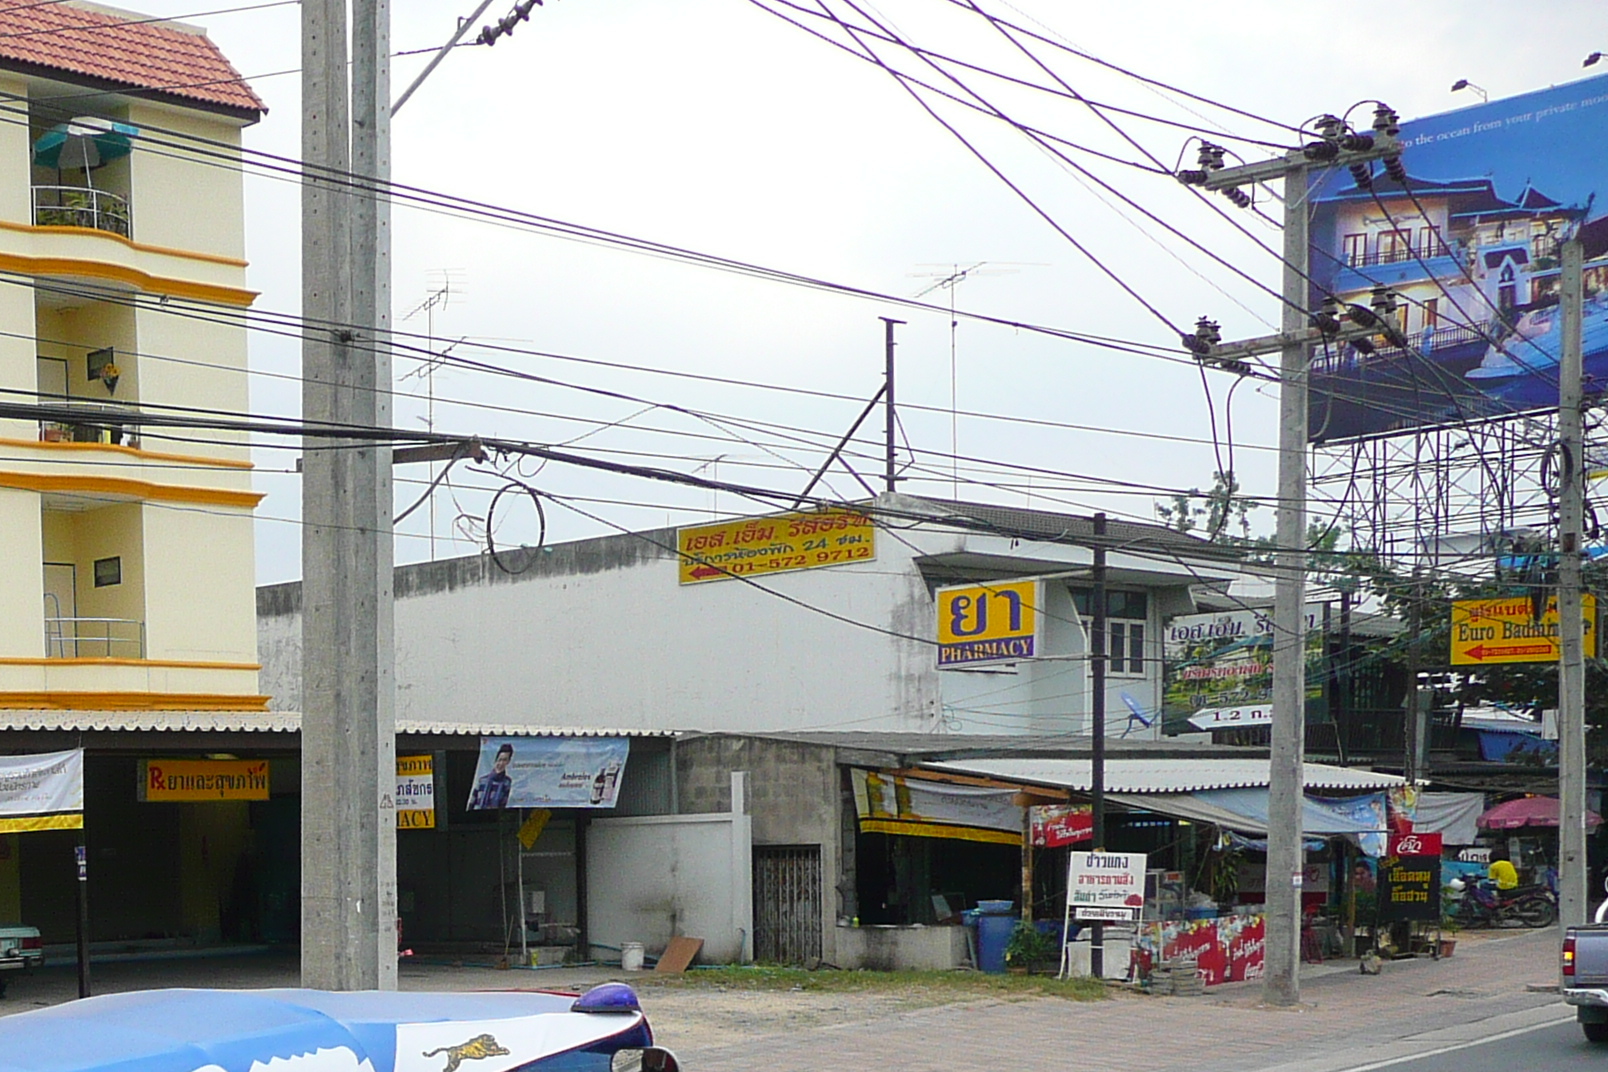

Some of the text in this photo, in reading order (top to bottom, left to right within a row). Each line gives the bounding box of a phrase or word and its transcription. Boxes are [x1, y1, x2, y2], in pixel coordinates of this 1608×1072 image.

[1415, 134, 1433, 145] the
[1437, 128, 1470, 140] ocean
[1474, 121, 1502, 133] from
[1506, 114, 1532, 127] your
[1536, 102, 1576, 122] private
[803, 537, 827, 551] 24
[732, 547, 870, 573] 01-572 9712
[951, 590, 1021, 637] ยา
[1458, 623, 1495, 641] Euro
[942, 639, 1030, 662] PHARMACY
[1213, 709, 1273, 721] 1.2 ก.
[396, 778, 432, 797] ภสัชกร
